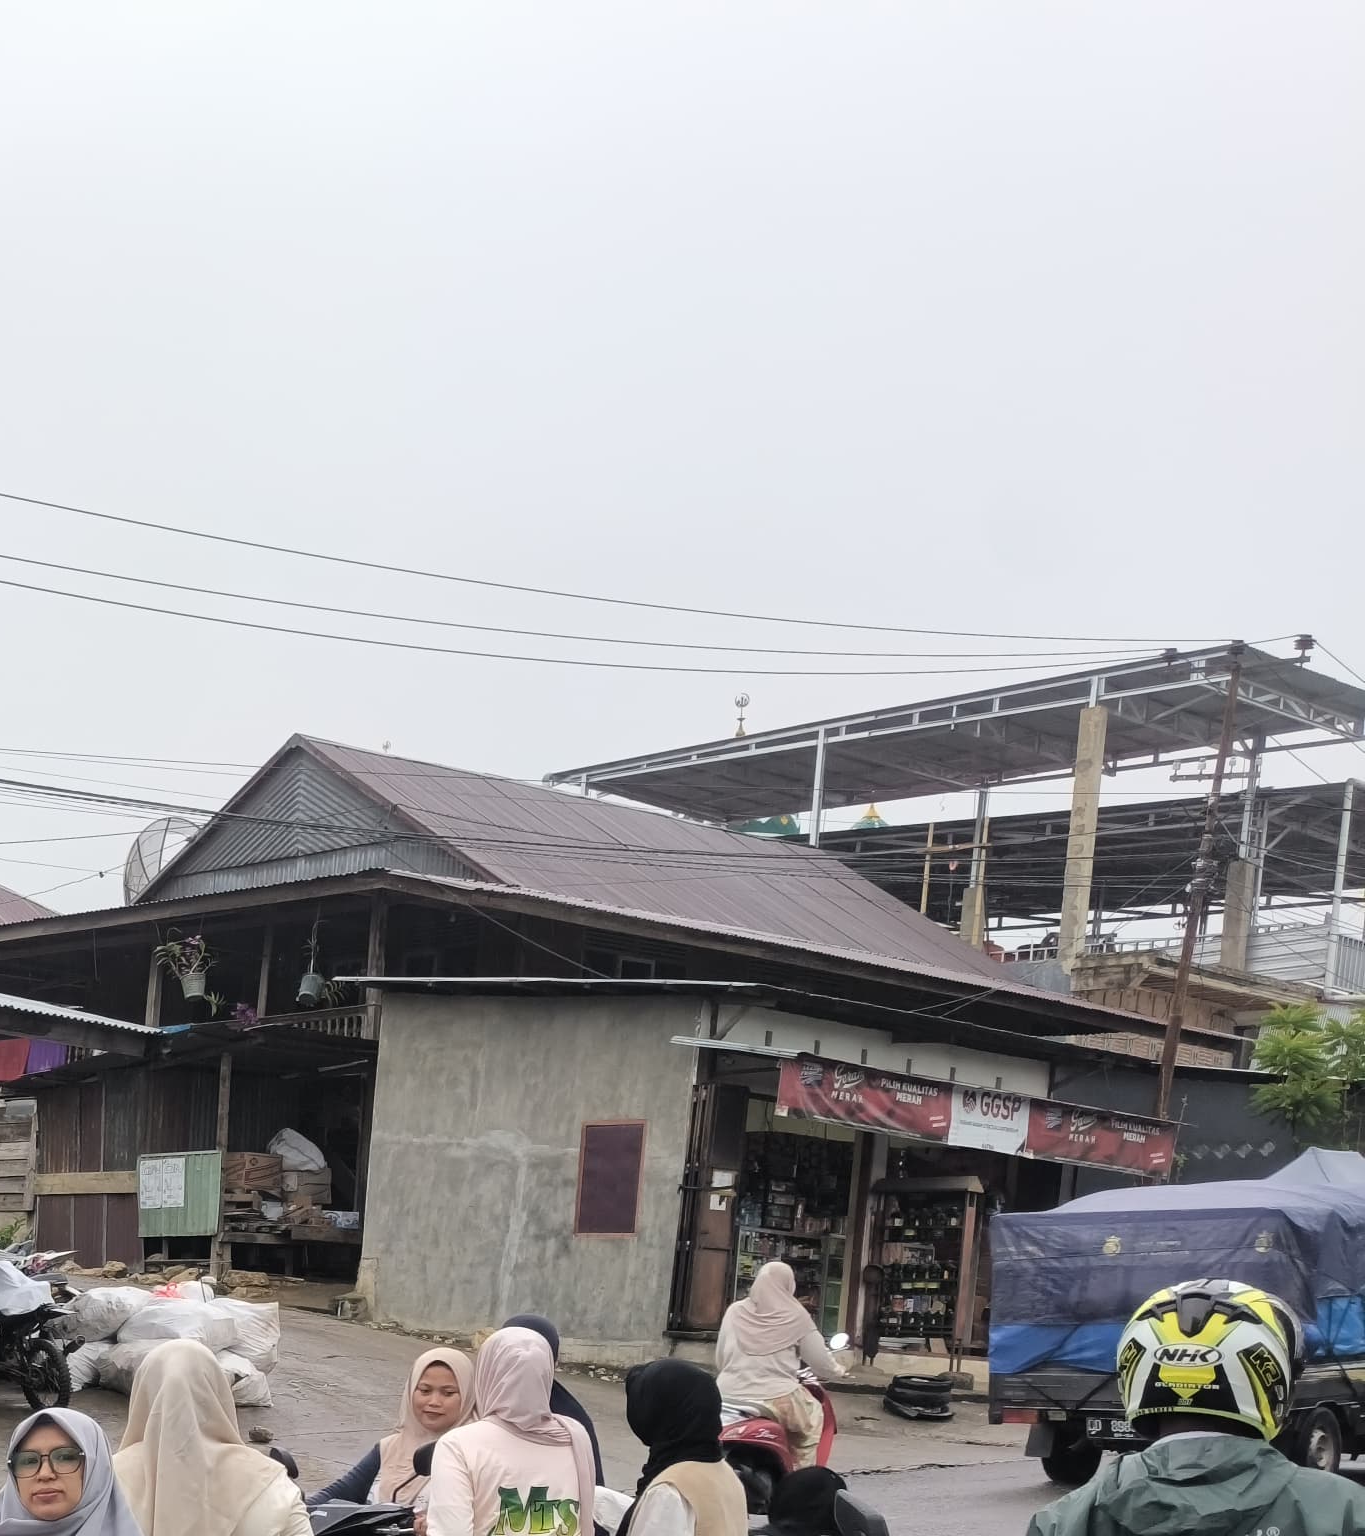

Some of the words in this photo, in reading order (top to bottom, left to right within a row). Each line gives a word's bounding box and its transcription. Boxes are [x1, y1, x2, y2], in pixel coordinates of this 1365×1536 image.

[896, 1091, 922, 1105] MERAH
[980, 1092, 1022, 1121] GGSP
[1158, 1348, 1214, 1363] NHK
[1154, 1381, 1220, 1390] GLADIATOR
